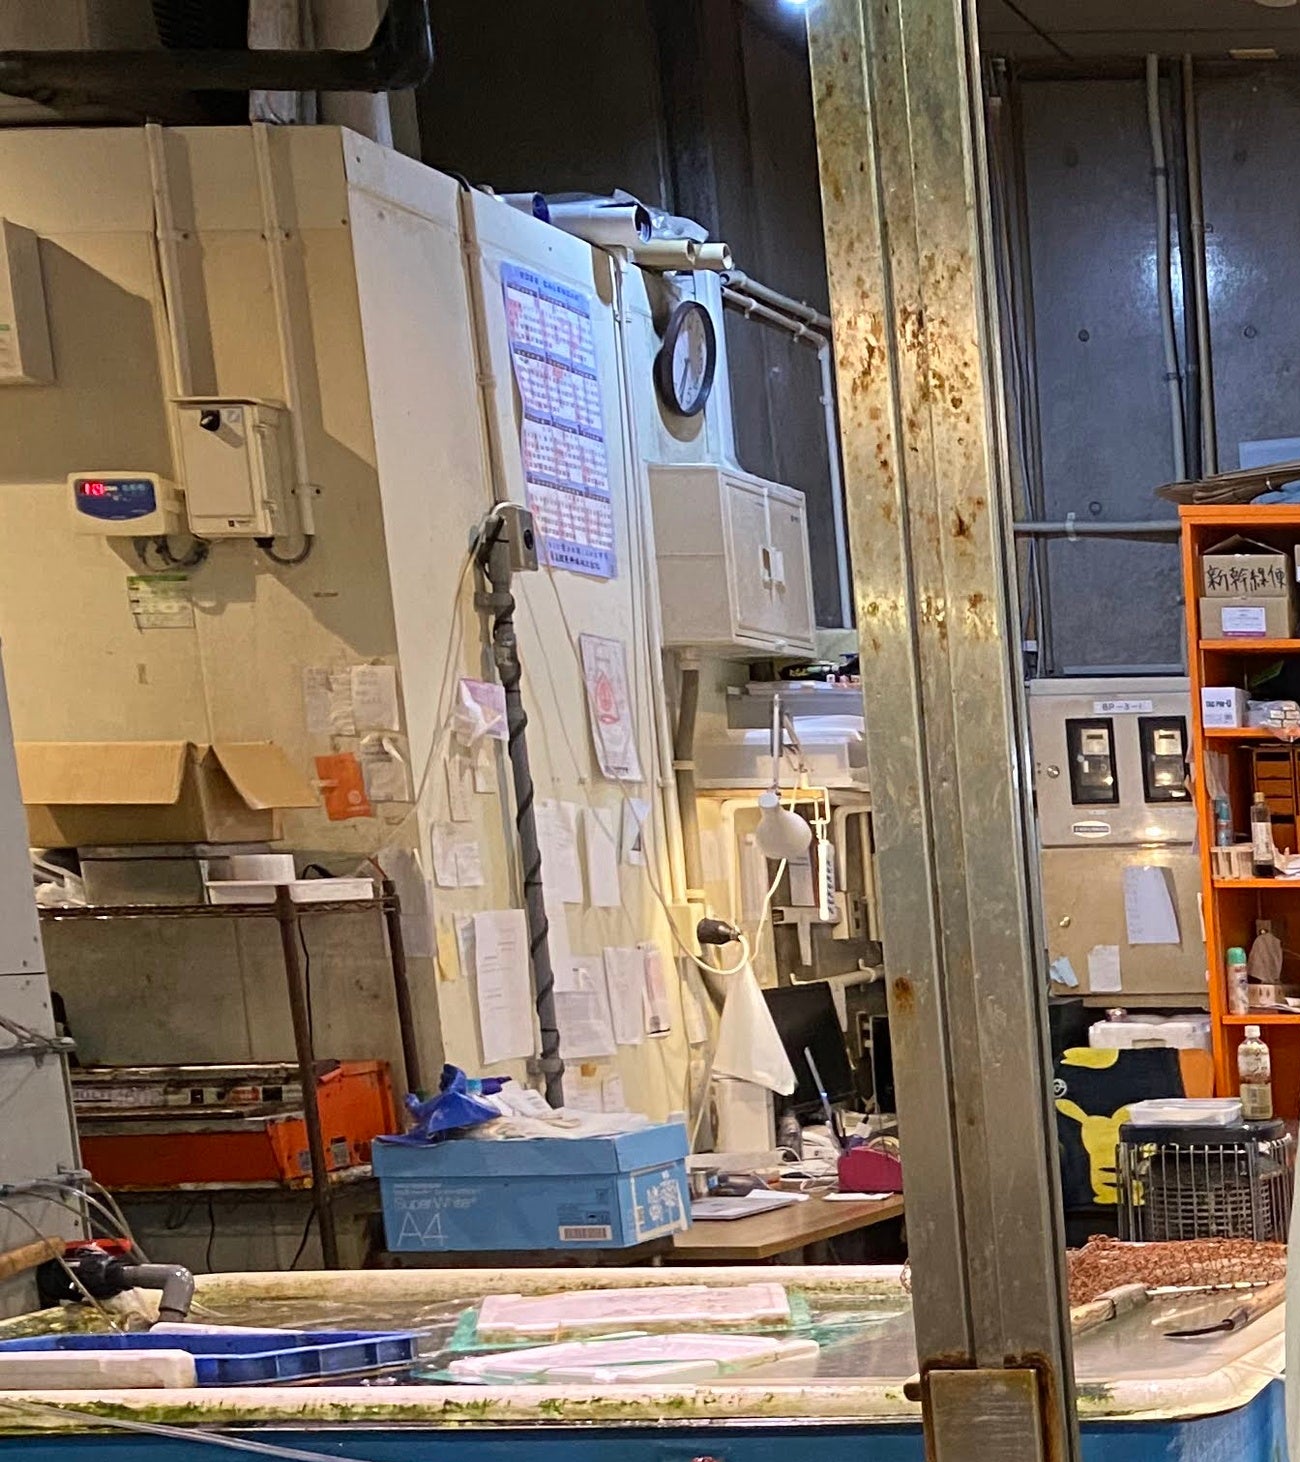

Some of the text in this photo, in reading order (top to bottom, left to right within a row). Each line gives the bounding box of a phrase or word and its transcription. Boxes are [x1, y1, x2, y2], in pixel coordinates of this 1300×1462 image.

[1207, 564, 1287, 592] 新幹線便
[396, 1211, 448, 1248] A4
